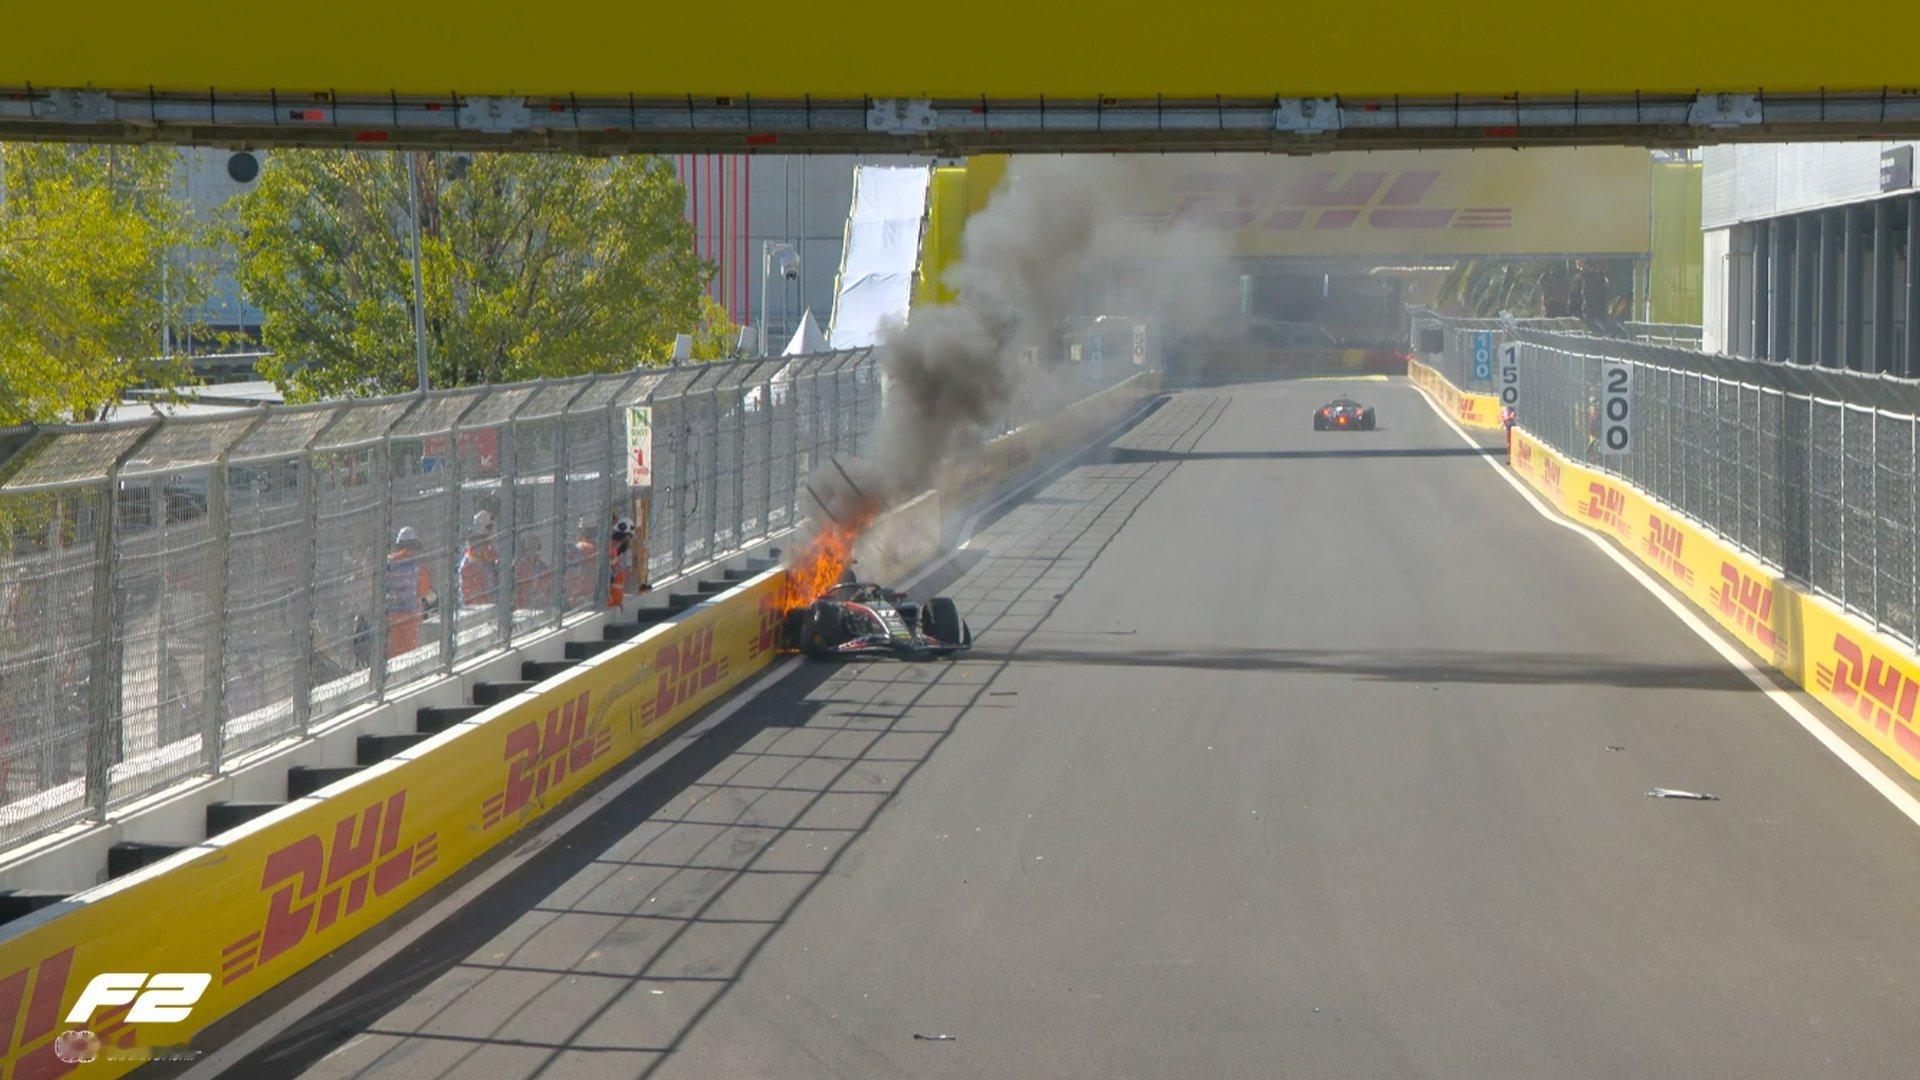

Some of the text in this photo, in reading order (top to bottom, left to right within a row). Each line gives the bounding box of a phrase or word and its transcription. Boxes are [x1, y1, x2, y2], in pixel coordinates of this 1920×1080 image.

[1475, 334, 1489, 378] 100
[1502, 346, 1518, 404] 150
[1606, 368, 1629, 450] 200
[1588, 482, 1629, 534] DHL
[1648, 514, 1687, 580] DHL
[1719, 561, 1777, 651] DHL
[654, 623, 719, 721] DHL
[1830, 632, 1920, 763] DHL
[502, 689, 596, 820] DHL
[258, 788, 416, 968] DHL
